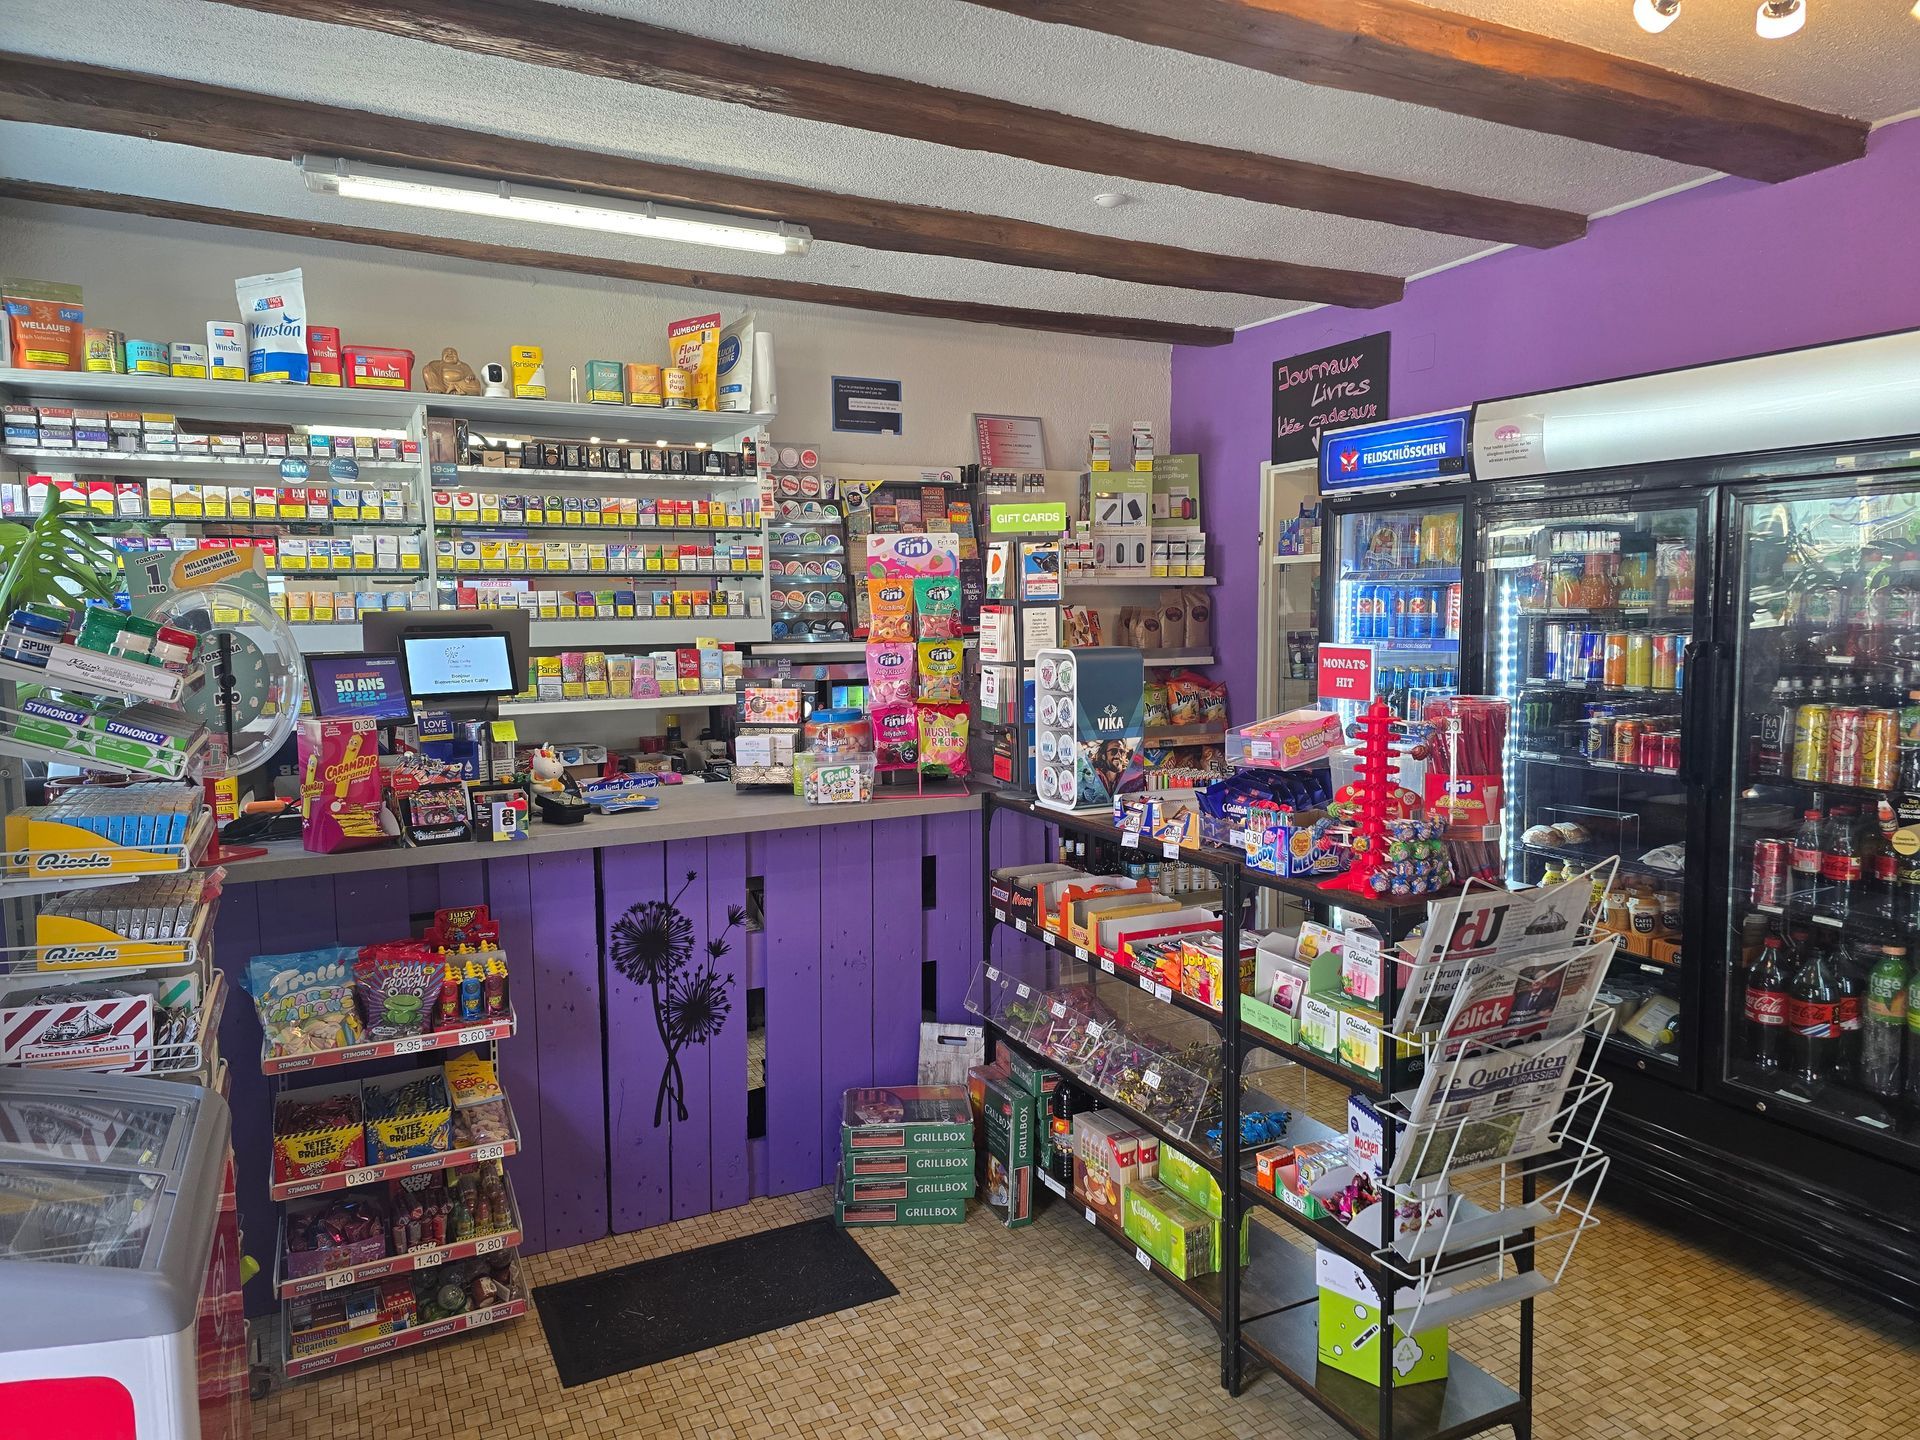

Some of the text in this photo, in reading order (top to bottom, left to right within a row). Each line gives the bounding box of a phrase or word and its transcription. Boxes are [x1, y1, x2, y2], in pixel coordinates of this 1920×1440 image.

[21, 321, 71, 333] WELLAUER
[252, 324, 300, 339] Winston
[673, 321, 715, 336] JUMBOPACK
[215, 343, 242, 352] Winston
[312, 348, 337, 358] Winston
[679, 344, 701, 355] Fleur
[182, 353, 204, 361] Winston
[679, 355, 690, 364] du
[372, 367, 400, 378] Winston
[1310, 378, 1371, 407] Livres
[13, 405, 34, 413] TEREA
[1309, 403, 1378, 429] cadeaux
[1363, 441, 1447, 465] FELDSCHLÖSSCHEN
[281, 465, 306, 473] NEW
[432, 465, 442, 473] 19
[951, 514, 967, 522] NEW
[997, 513, 1060, 523] GIFT CARDS
[897, 540, 928, 555] Fini
[136, 553, 165, 565] FORTUNA
[184, 550, 236, 571] MILLIONNAIRE
[185, 558, 237, 579] AUJOURD'HUI MÊME
[148, 585, 167, 594] MIO
[880, 591, 904, 600] Fini
[928, 591, 950, 600] Fini
[880, 655, 902, 665] Fini
[930, 651, 953, 660] Fini
[1323, 658, 1369, 668] MONATS-
[335, 678, 385, 692] 30 ANS
[1336, 677, 1354, 688] HIT
[25, 702, 78, 723] STIMOROL
[354, 720, 375, 730] 0.30
[423, 720, 447, 728] LOVE
[884, 716, 906, 727] Fini
[1097, 716, 1124, 730] VIKA
[1766, 718, 1777, 728] KA
[107, 722, 159, 743] STIMOROL
[924, 728, 950, 737] MUSH
[1765, 729, 1776, 739] EX
[1302, 731, 1327, 750] CHEW
[326, 755, 377, 780] CARAMBAR
[825, 769, 848, 783] Trolli
[37, 854, 111, 870] Ricola
[1247, 846, 1275, 866] MELODY
[1315, 856, 1338, 869] POPS
[1012, 892, 1032, 906] Mars
[448, 910, 477, 919] JUICY
[44, 948, 118, 964] Ricola
[1348, 950, 1373, 966] Ricola
[392, 965, 422, 977] COLA
[1102, 960, 1114, 972] 1.45
[270, 963, 345, 995] Trolli
[987, 968, 999, 979] 0.40
[1141, 977, 1153, 992] 1.50
[1871, 972, 1901, 989] fuse
[1871, 985, 1892, 998] tea
[280, 987, 344, 1011] MARSH
[270, 997, 355, 1022] MALLOWS
[1053, 1004, 1065, 1016] 0.20
[1306, 1001, 1330, 1018] Ricola
[1453, 1003, 1505, 1031] Blick
[1088, 1023, 1100, 1036] 0.25
[1345, 1017, 1371, 1035] Ricola
[460, 1030, 485, 1043] 3.60
[395, 1041, 421, 1053] 2.95
[342, 1049, 372, 1060] STIMOROL
[278, 1059, 309, 1070] STIMOROL
[1469, 1053, 1567, 1089] Quotidien
[1145, 1073, 1159, 1086] 0.20
[1508, 1068, 1562, 1087] JURASSIEN
[913, 1132, 966, 1142] GRILLBOX
[1018, 1106, 1029, 1158] GRILLBOX
[479, 1146, 503, 1158] 3.80
[1354, 1136, 1378, 1156] Mocken
[300, 1158, 330, 1175] BARRES
[411, 1160, 442, 1171] STIMOROL
[916, 1157, 968, 1168] GRILLBOX
[348, 1171, 374, 1184] 0.30
[400, 1173, 433, 1186] PUSH
[287, 1183, 319, 1195] STIMOROL
[405, 1181, 431, 1193] POP
[916, 1182, 968, 1193] GRILLBOX
[905, 1207, 958, 1217] GRILLBOX
[1130, 1200, 1161, 1232] Kleenex
[477, 1238, 501, 1253] 2.80
[416, 1253, 440, 1267] 1.40
[328, 1272, 353, 1286] 1.40
[387, 1297, 412, 1307] STAR
[349, 1308, 376, 1318] WORLD
[468, 1311, 491, 1326] 1.70
[297, 1338, 337, 1354] Cigarettes
[300, 1356, 333, 1370] STIMOROL
